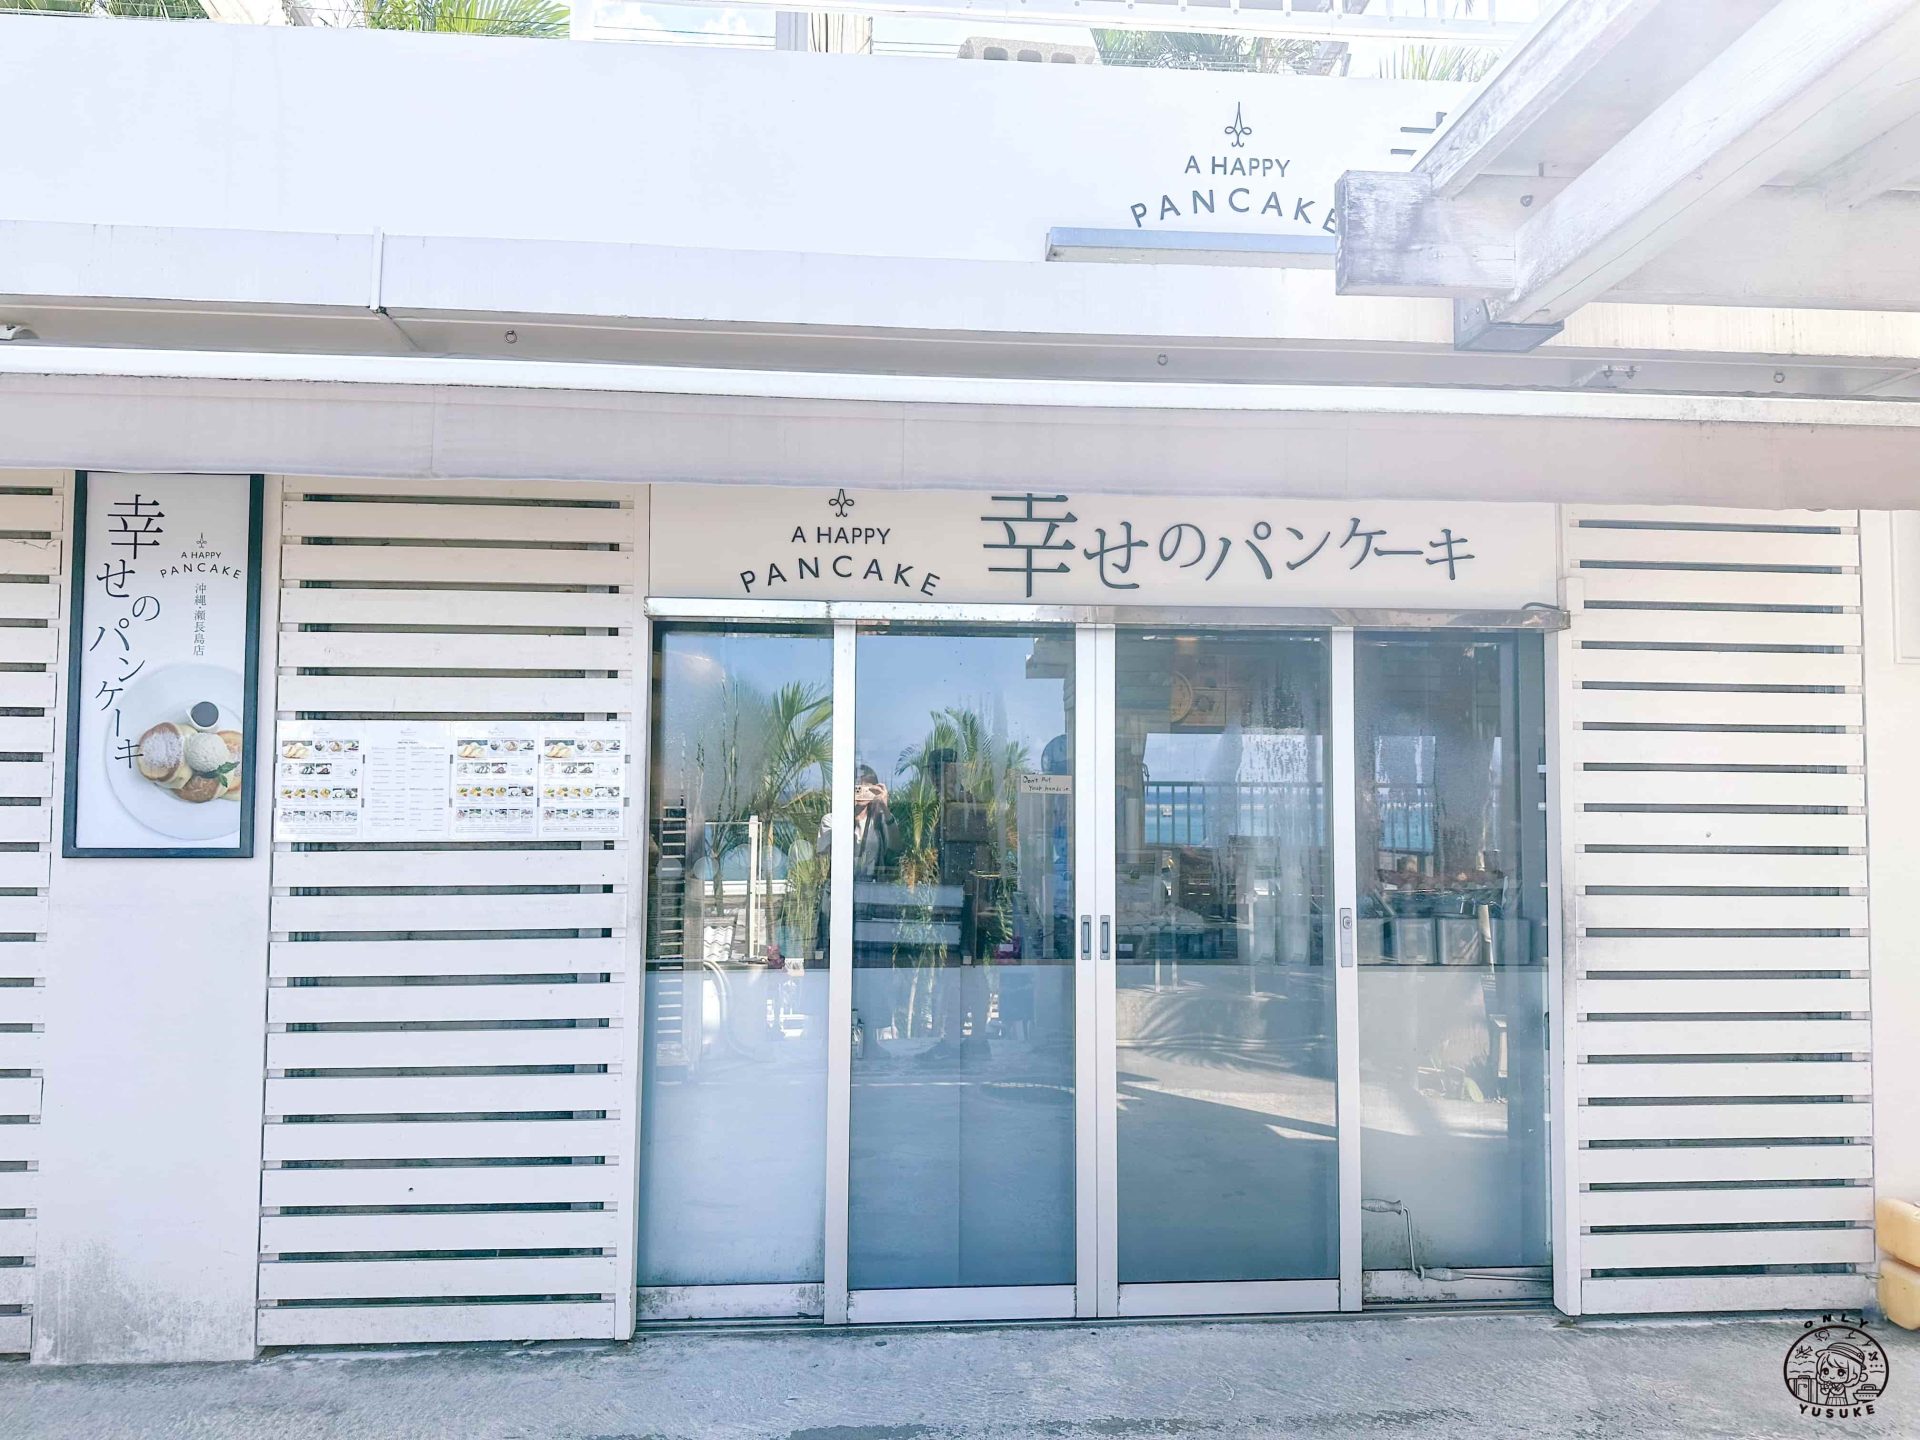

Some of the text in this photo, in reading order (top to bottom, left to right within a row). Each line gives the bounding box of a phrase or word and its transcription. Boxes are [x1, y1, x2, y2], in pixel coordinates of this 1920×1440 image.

[1184, 155, 1291, 178] A HAPPY
[791, 525, 891, 545] A HAPPY
[981, 493, 1475, 598] 幸せのパンケーキ
[180, 551, 222, 559] A HAPPY
[160, 562, 242, 580] PANCAKE
[740, 555, 941, 597] PANCAKE
[89, 494, 165, 769] 幸せのパンケーキ
